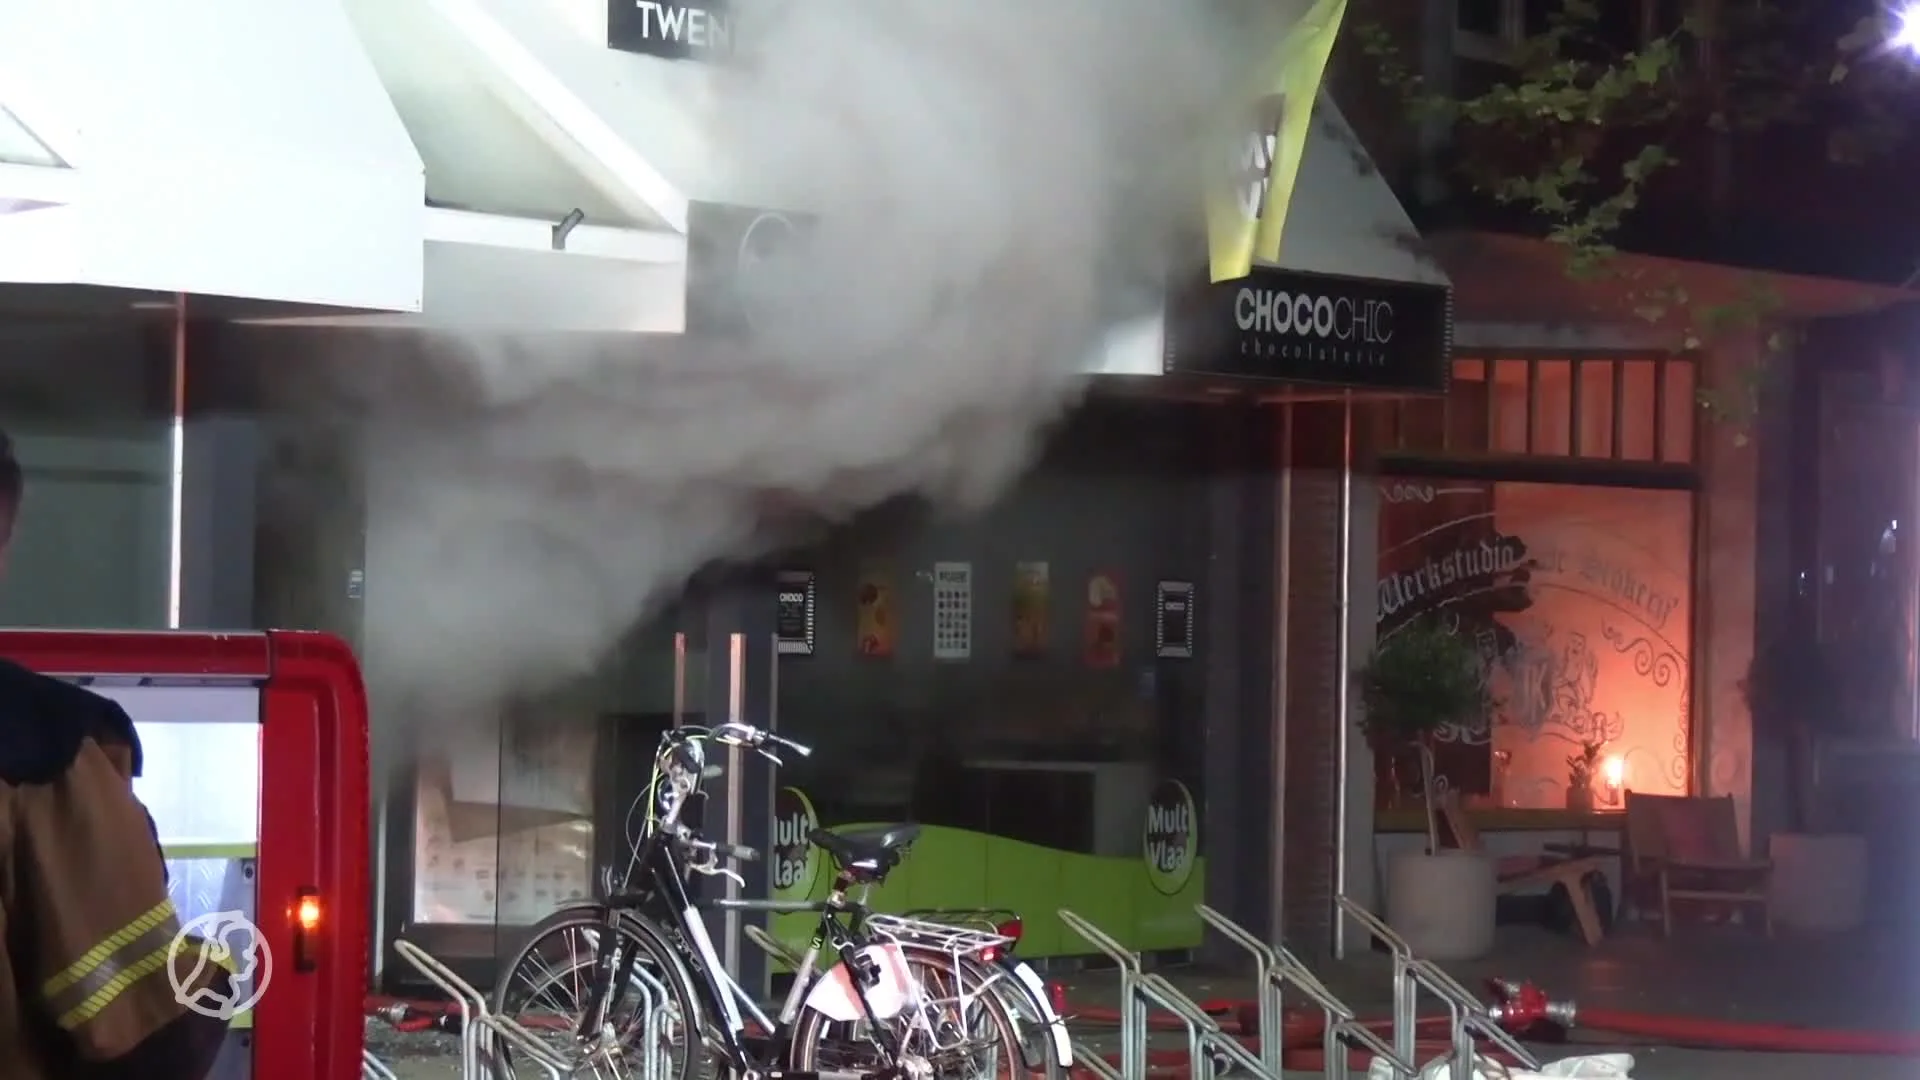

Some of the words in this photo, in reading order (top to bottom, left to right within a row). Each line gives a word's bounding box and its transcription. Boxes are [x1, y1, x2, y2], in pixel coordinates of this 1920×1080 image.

[1235, 287, 1393, 344] CHOCOCHIC
[1241, 339, 1386, 366] chocolaterie
[1376, 539, 1514, 623] Werkstudio
